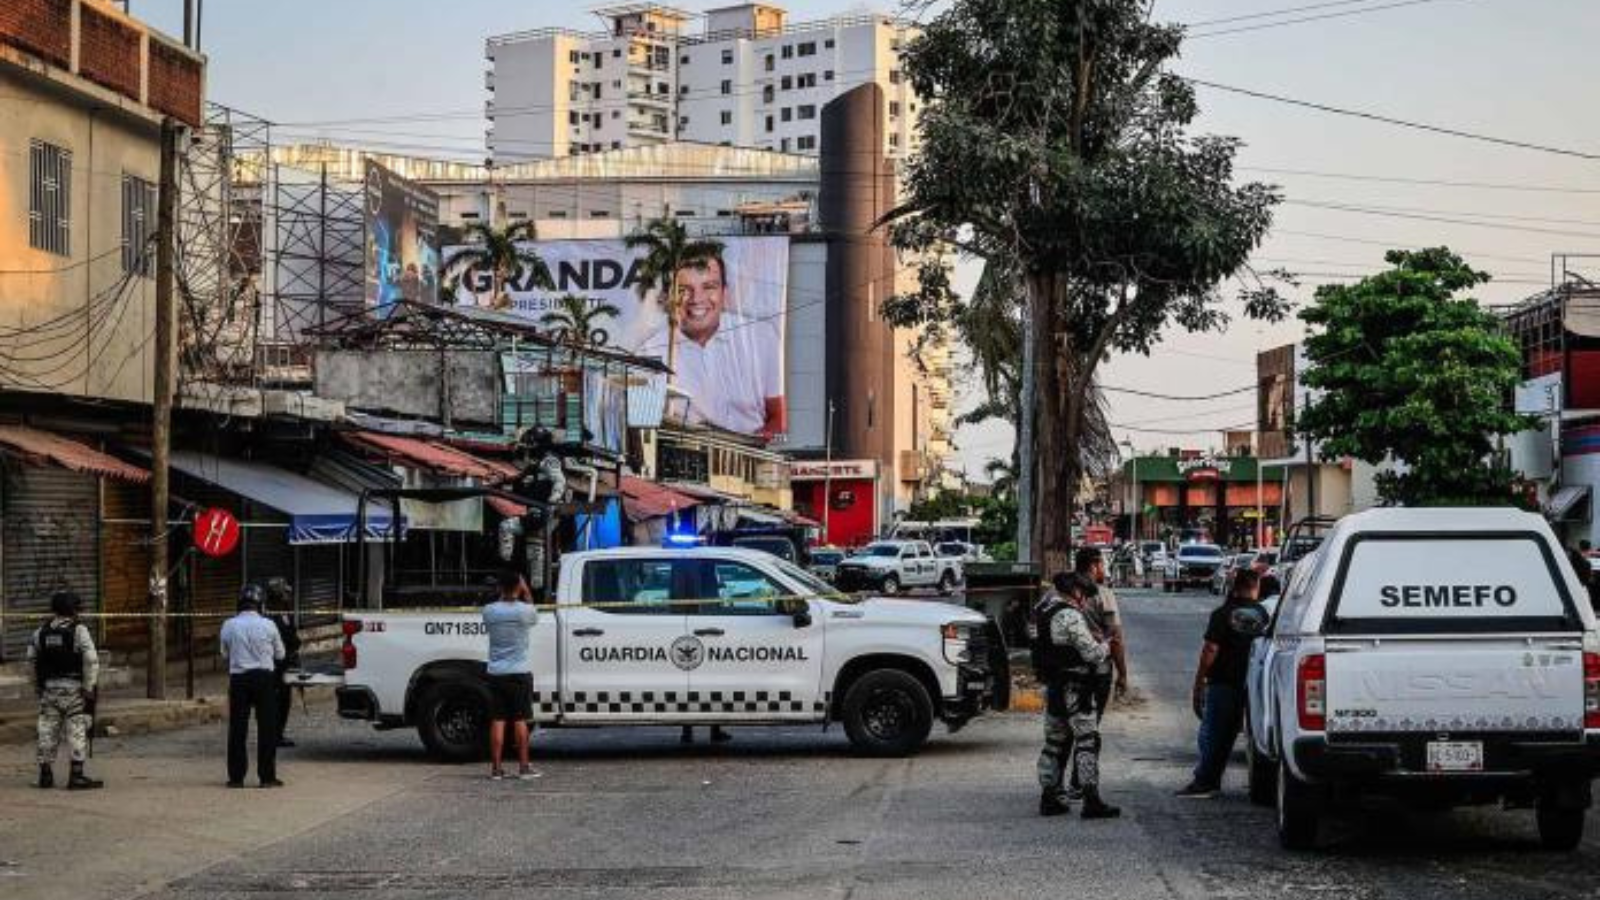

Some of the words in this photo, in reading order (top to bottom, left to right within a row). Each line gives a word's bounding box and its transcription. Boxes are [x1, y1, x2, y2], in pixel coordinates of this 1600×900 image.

[1380, 585, 1518, 608] SEMEFO
[579, 646, 667, 663] GUARDIA
[706, 646, 809, 662] NACIONAL
